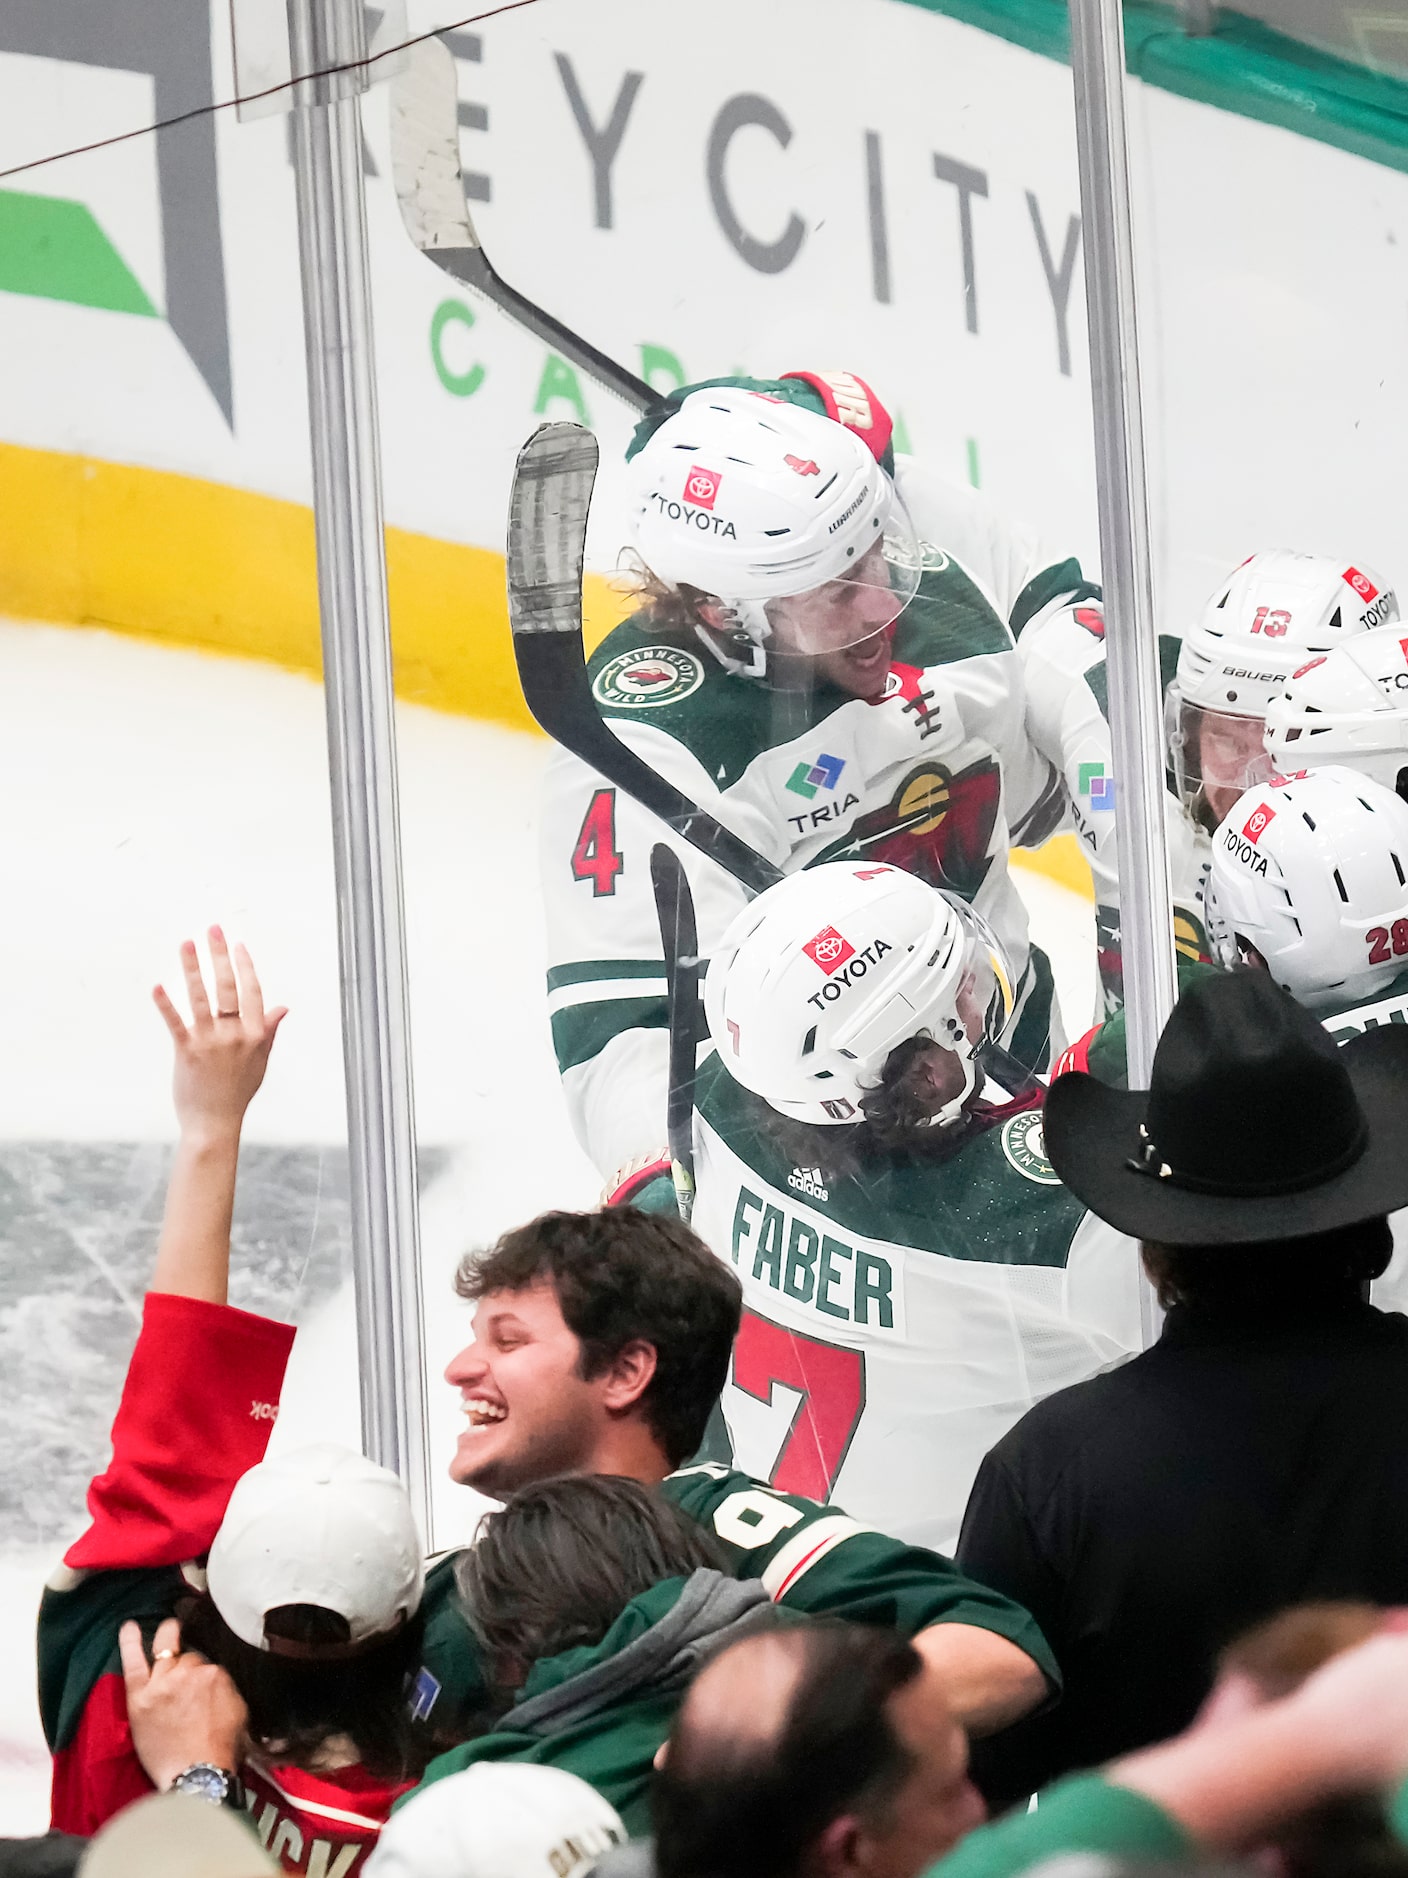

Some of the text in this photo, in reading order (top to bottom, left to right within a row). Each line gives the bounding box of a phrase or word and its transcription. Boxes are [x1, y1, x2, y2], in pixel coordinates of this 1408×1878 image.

[706, 91, 1082, 377] CITY
[657, 496, 737, 541] TOYOTA
[828, 485, 870, 535] WARRIOR
[1250, 606, 1292, 638] 13
[618, 650, 694, 684] MINNESOTA
[604, 687, 647, 703] WILD
[788, 791, 860, 834] TRIA
[1071, 800, 1097, 851] RIA
[570, 787, 624, 898] 4
[1222, 828, 1270, 878] TOYOTA
[807, 938, 893, 1011] TOYOTA
[787, 1171, 829, 1203] adidas
[731, 1184, 894, 1329] FABER
[731, 1305, 867, 1505] 7
